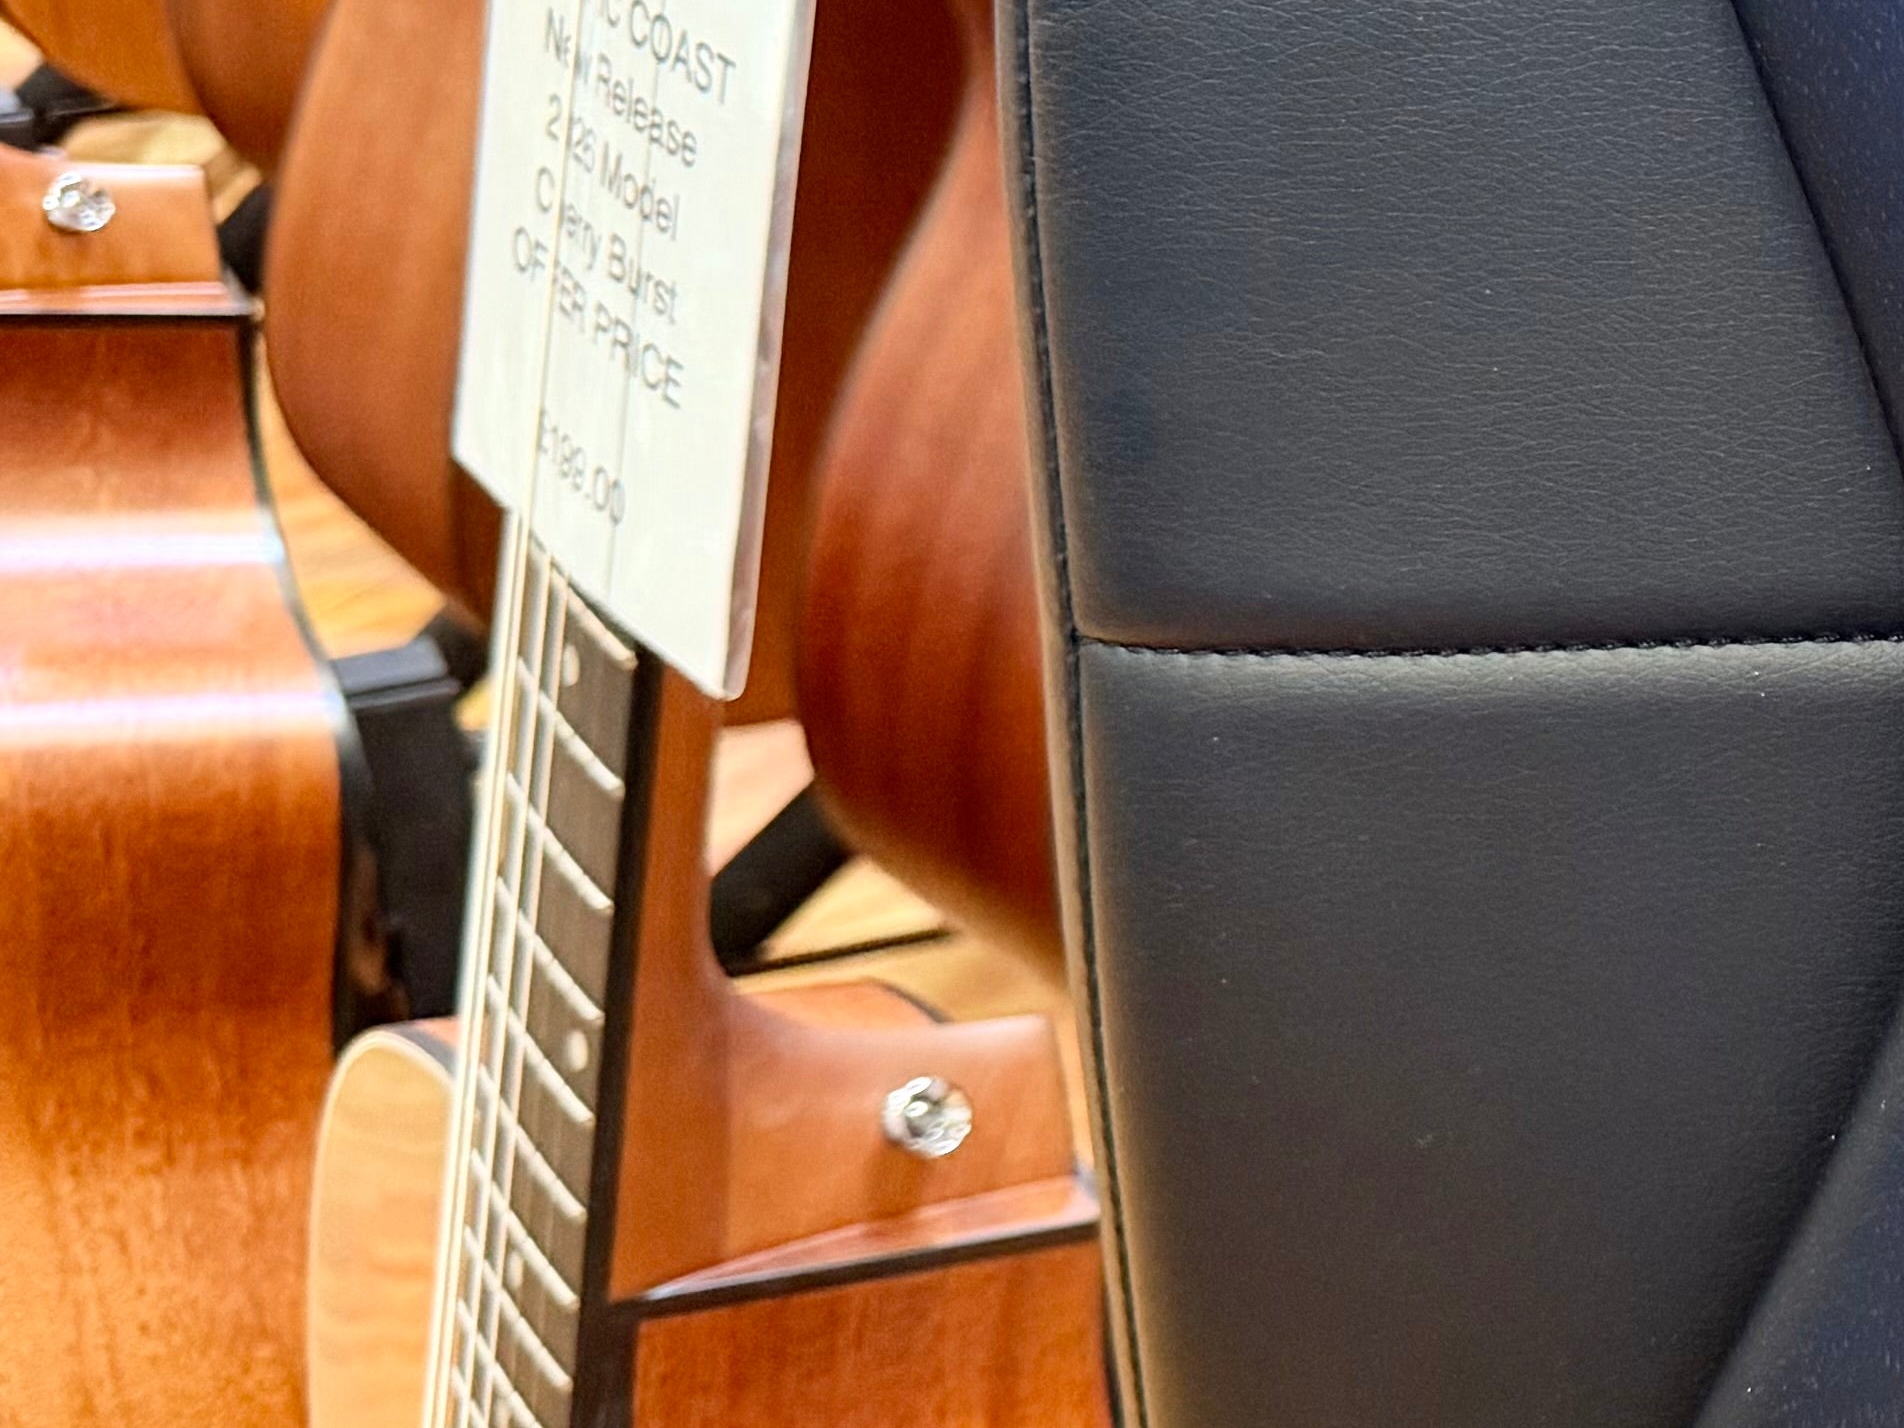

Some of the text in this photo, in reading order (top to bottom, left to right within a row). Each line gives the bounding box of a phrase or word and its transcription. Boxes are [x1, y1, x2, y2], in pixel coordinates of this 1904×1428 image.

[545, 92, 681, 242] 225 Model
[596, 52, 698, 168] Release
[535, 166, 679, 325] Cerry Burst
[594, 301, 685, 411] PRICE
